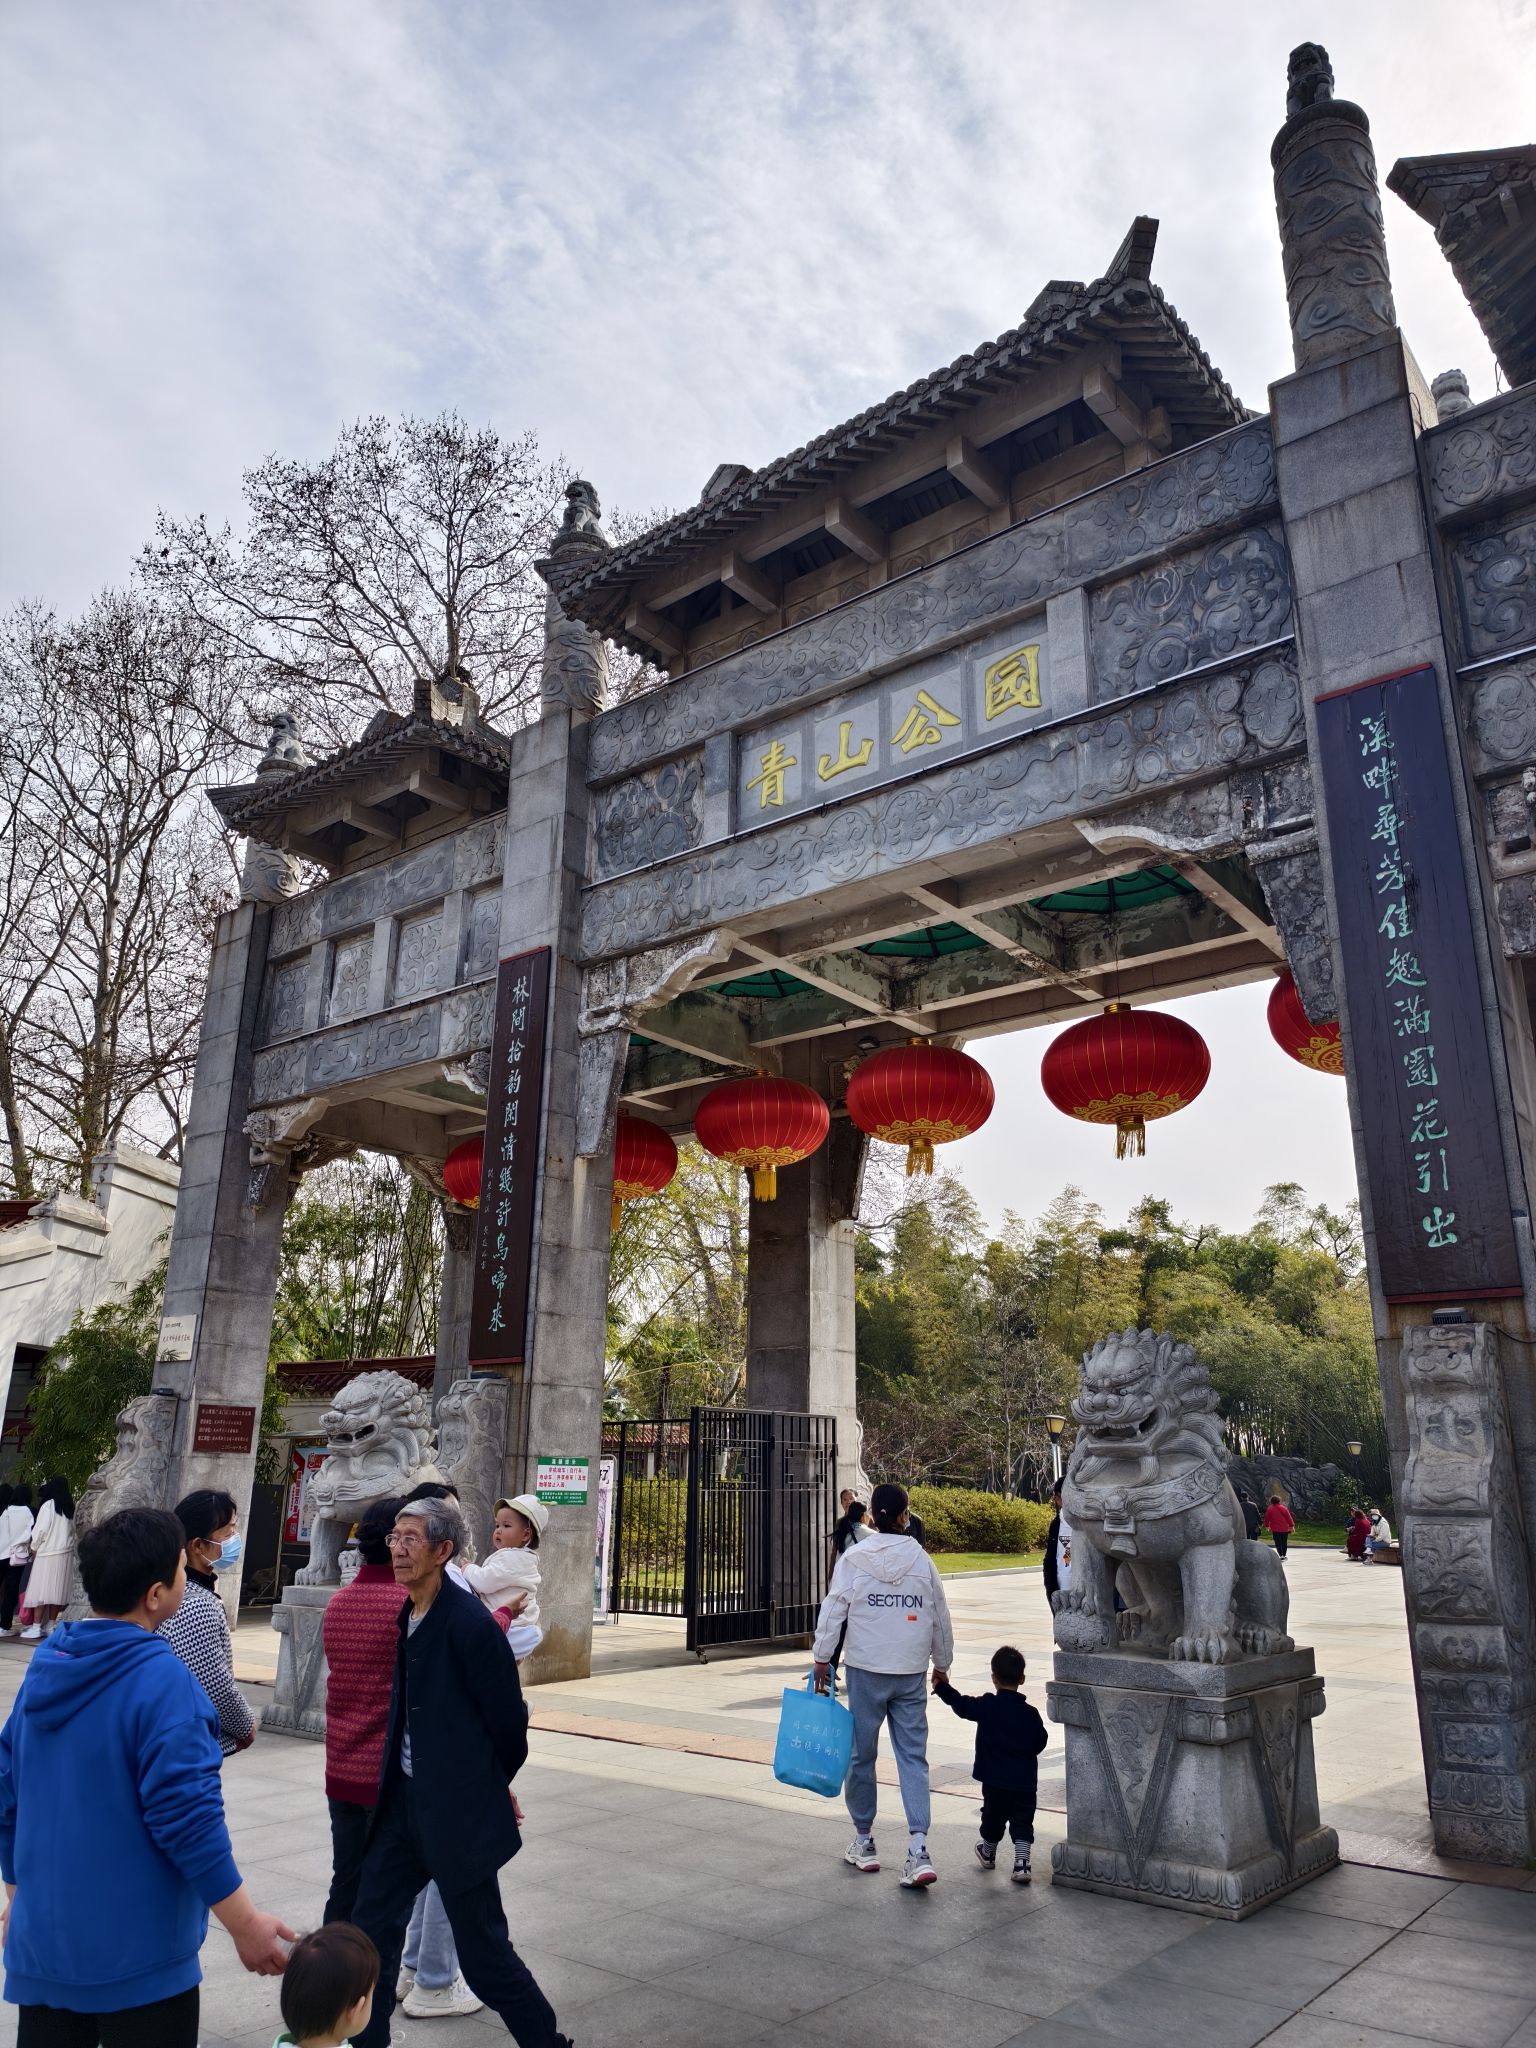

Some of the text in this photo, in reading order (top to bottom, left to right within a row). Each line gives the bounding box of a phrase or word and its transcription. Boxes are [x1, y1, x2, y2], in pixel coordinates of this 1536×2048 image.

[746, 644, 1042, 809] 青山公园
[867, 1593, 923, 1609] SECTION
